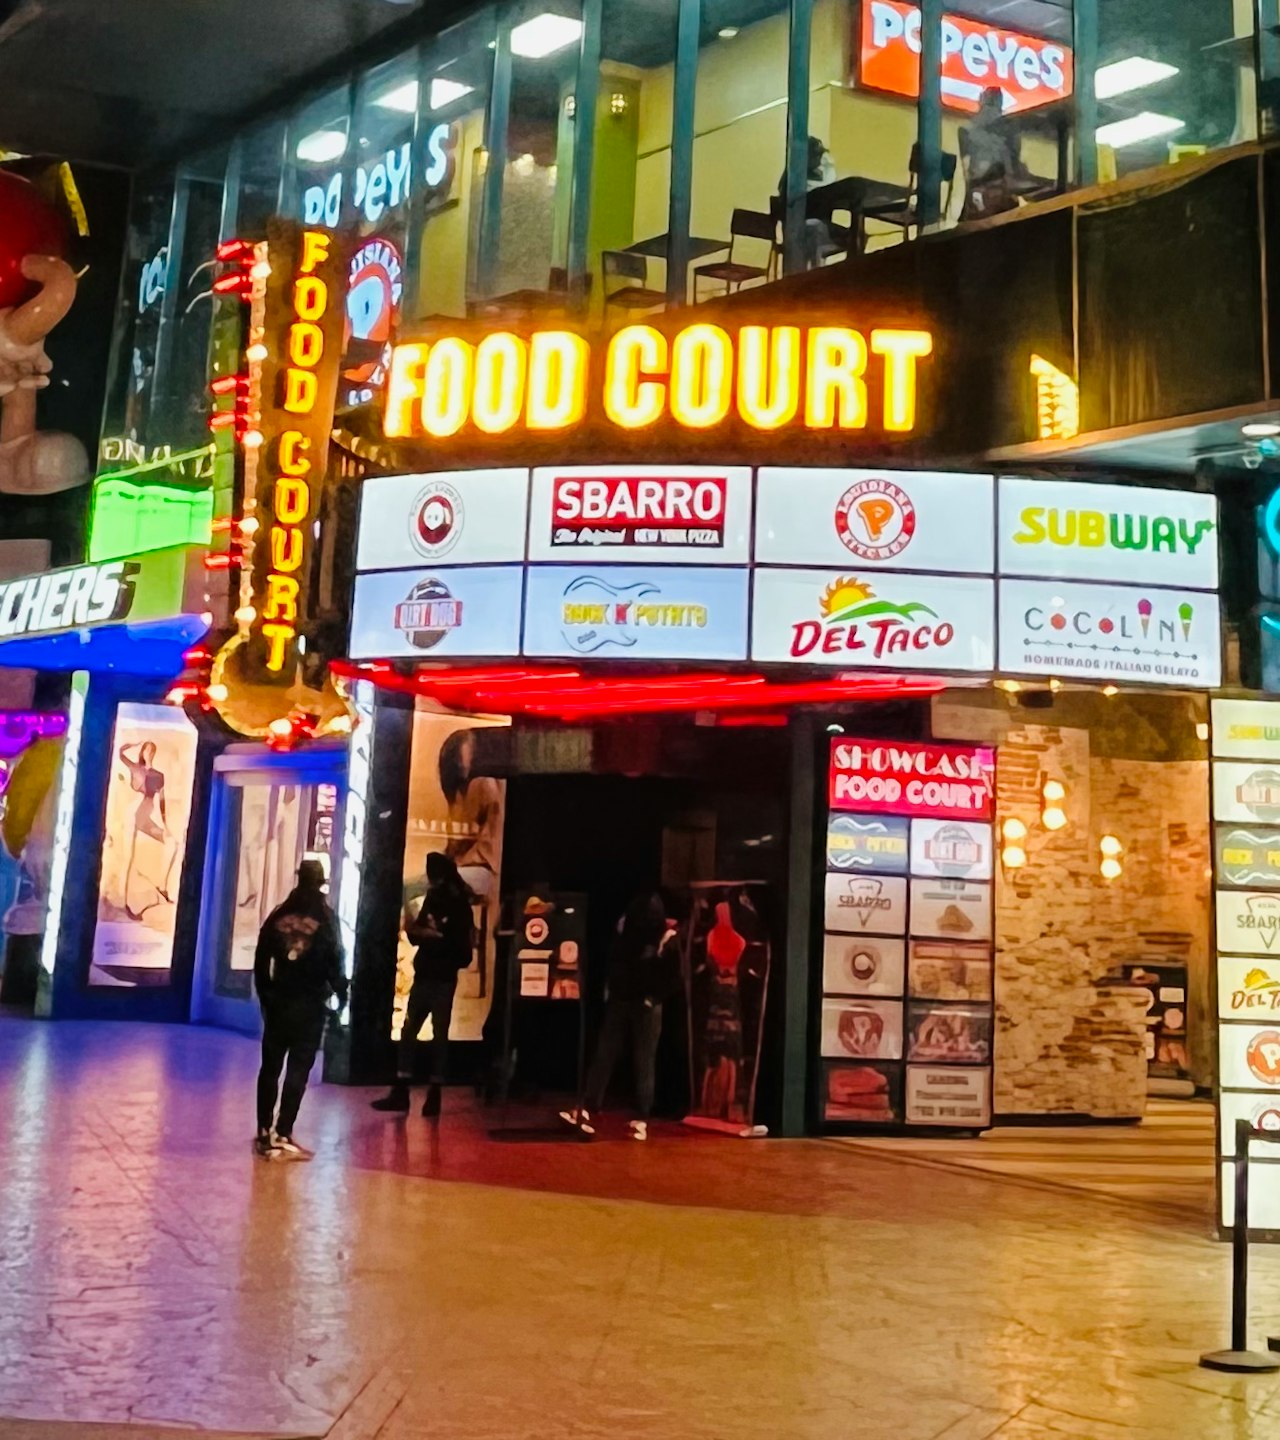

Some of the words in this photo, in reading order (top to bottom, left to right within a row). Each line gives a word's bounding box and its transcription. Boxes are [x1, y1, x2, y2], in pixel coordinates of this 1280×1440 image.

[304, 123, 449, 228] POeYS
[284, 231, 331, 414] FOOD
[382, 330, 586, 439] FOOD
[603, 323, 933, 433] COURT
[556, 480, 722, 521] SBARRO
[264, 429, 312, 672] COURT
[1012, 506, 1216, 555] SUBWAY
[791, 619, 867, 657] DEL
[866, 618, 954, 659] TACO
[1023, 653, 1101, 670] HOMEMADE
[1103, 660, 1152, 674] ITALIAN
[1154, 665, 1199, 678] GELATO
[835, 774, 902, 803] FOOD
[906, 779, 988, 810] COURT
[1231, 990, 1266, 1010] DEL
